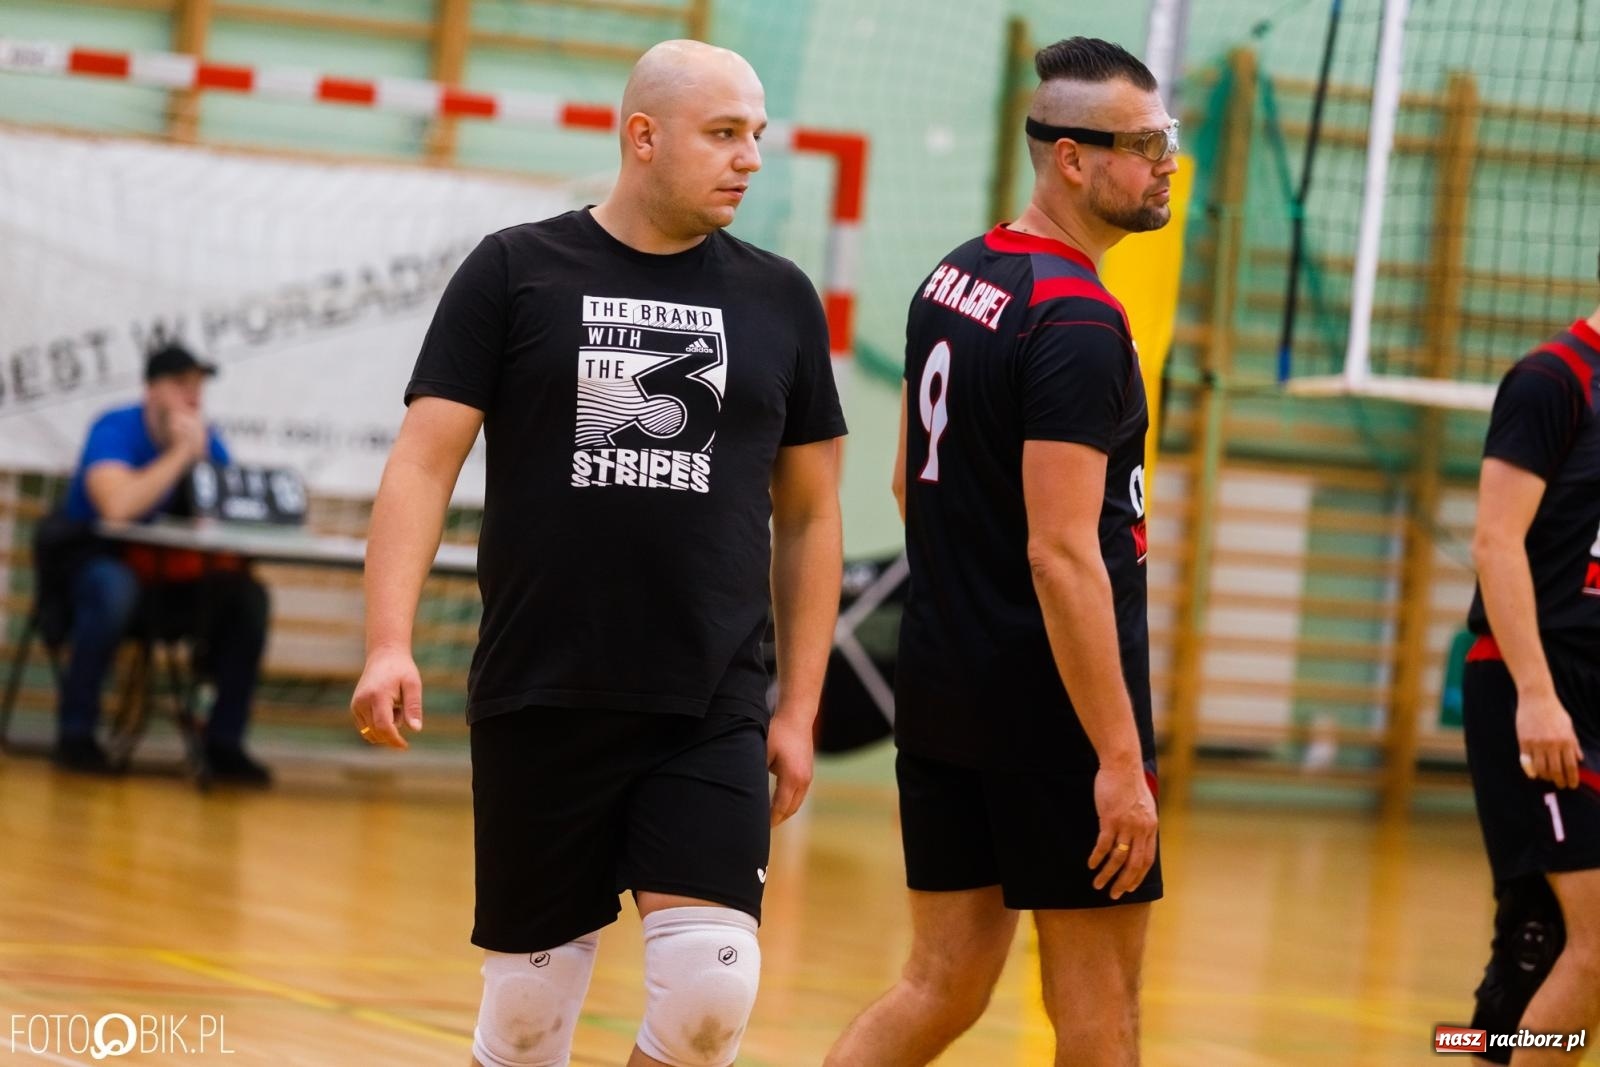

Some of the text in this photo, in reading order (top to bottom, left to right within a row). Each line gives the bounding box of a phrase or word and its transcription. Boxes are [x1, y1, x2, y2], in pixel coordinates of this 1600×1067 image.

[590, 301, 713, 328] THE BRAND
[588, 327, 642, 348] WITH
[685, 345, 714, 354] adidas
[0, 326, 112, 408] EST
[585, 359, 625, 380] THE
[918, 339, 951, 483] 9
[1543, 792, 1565, 842] 1
